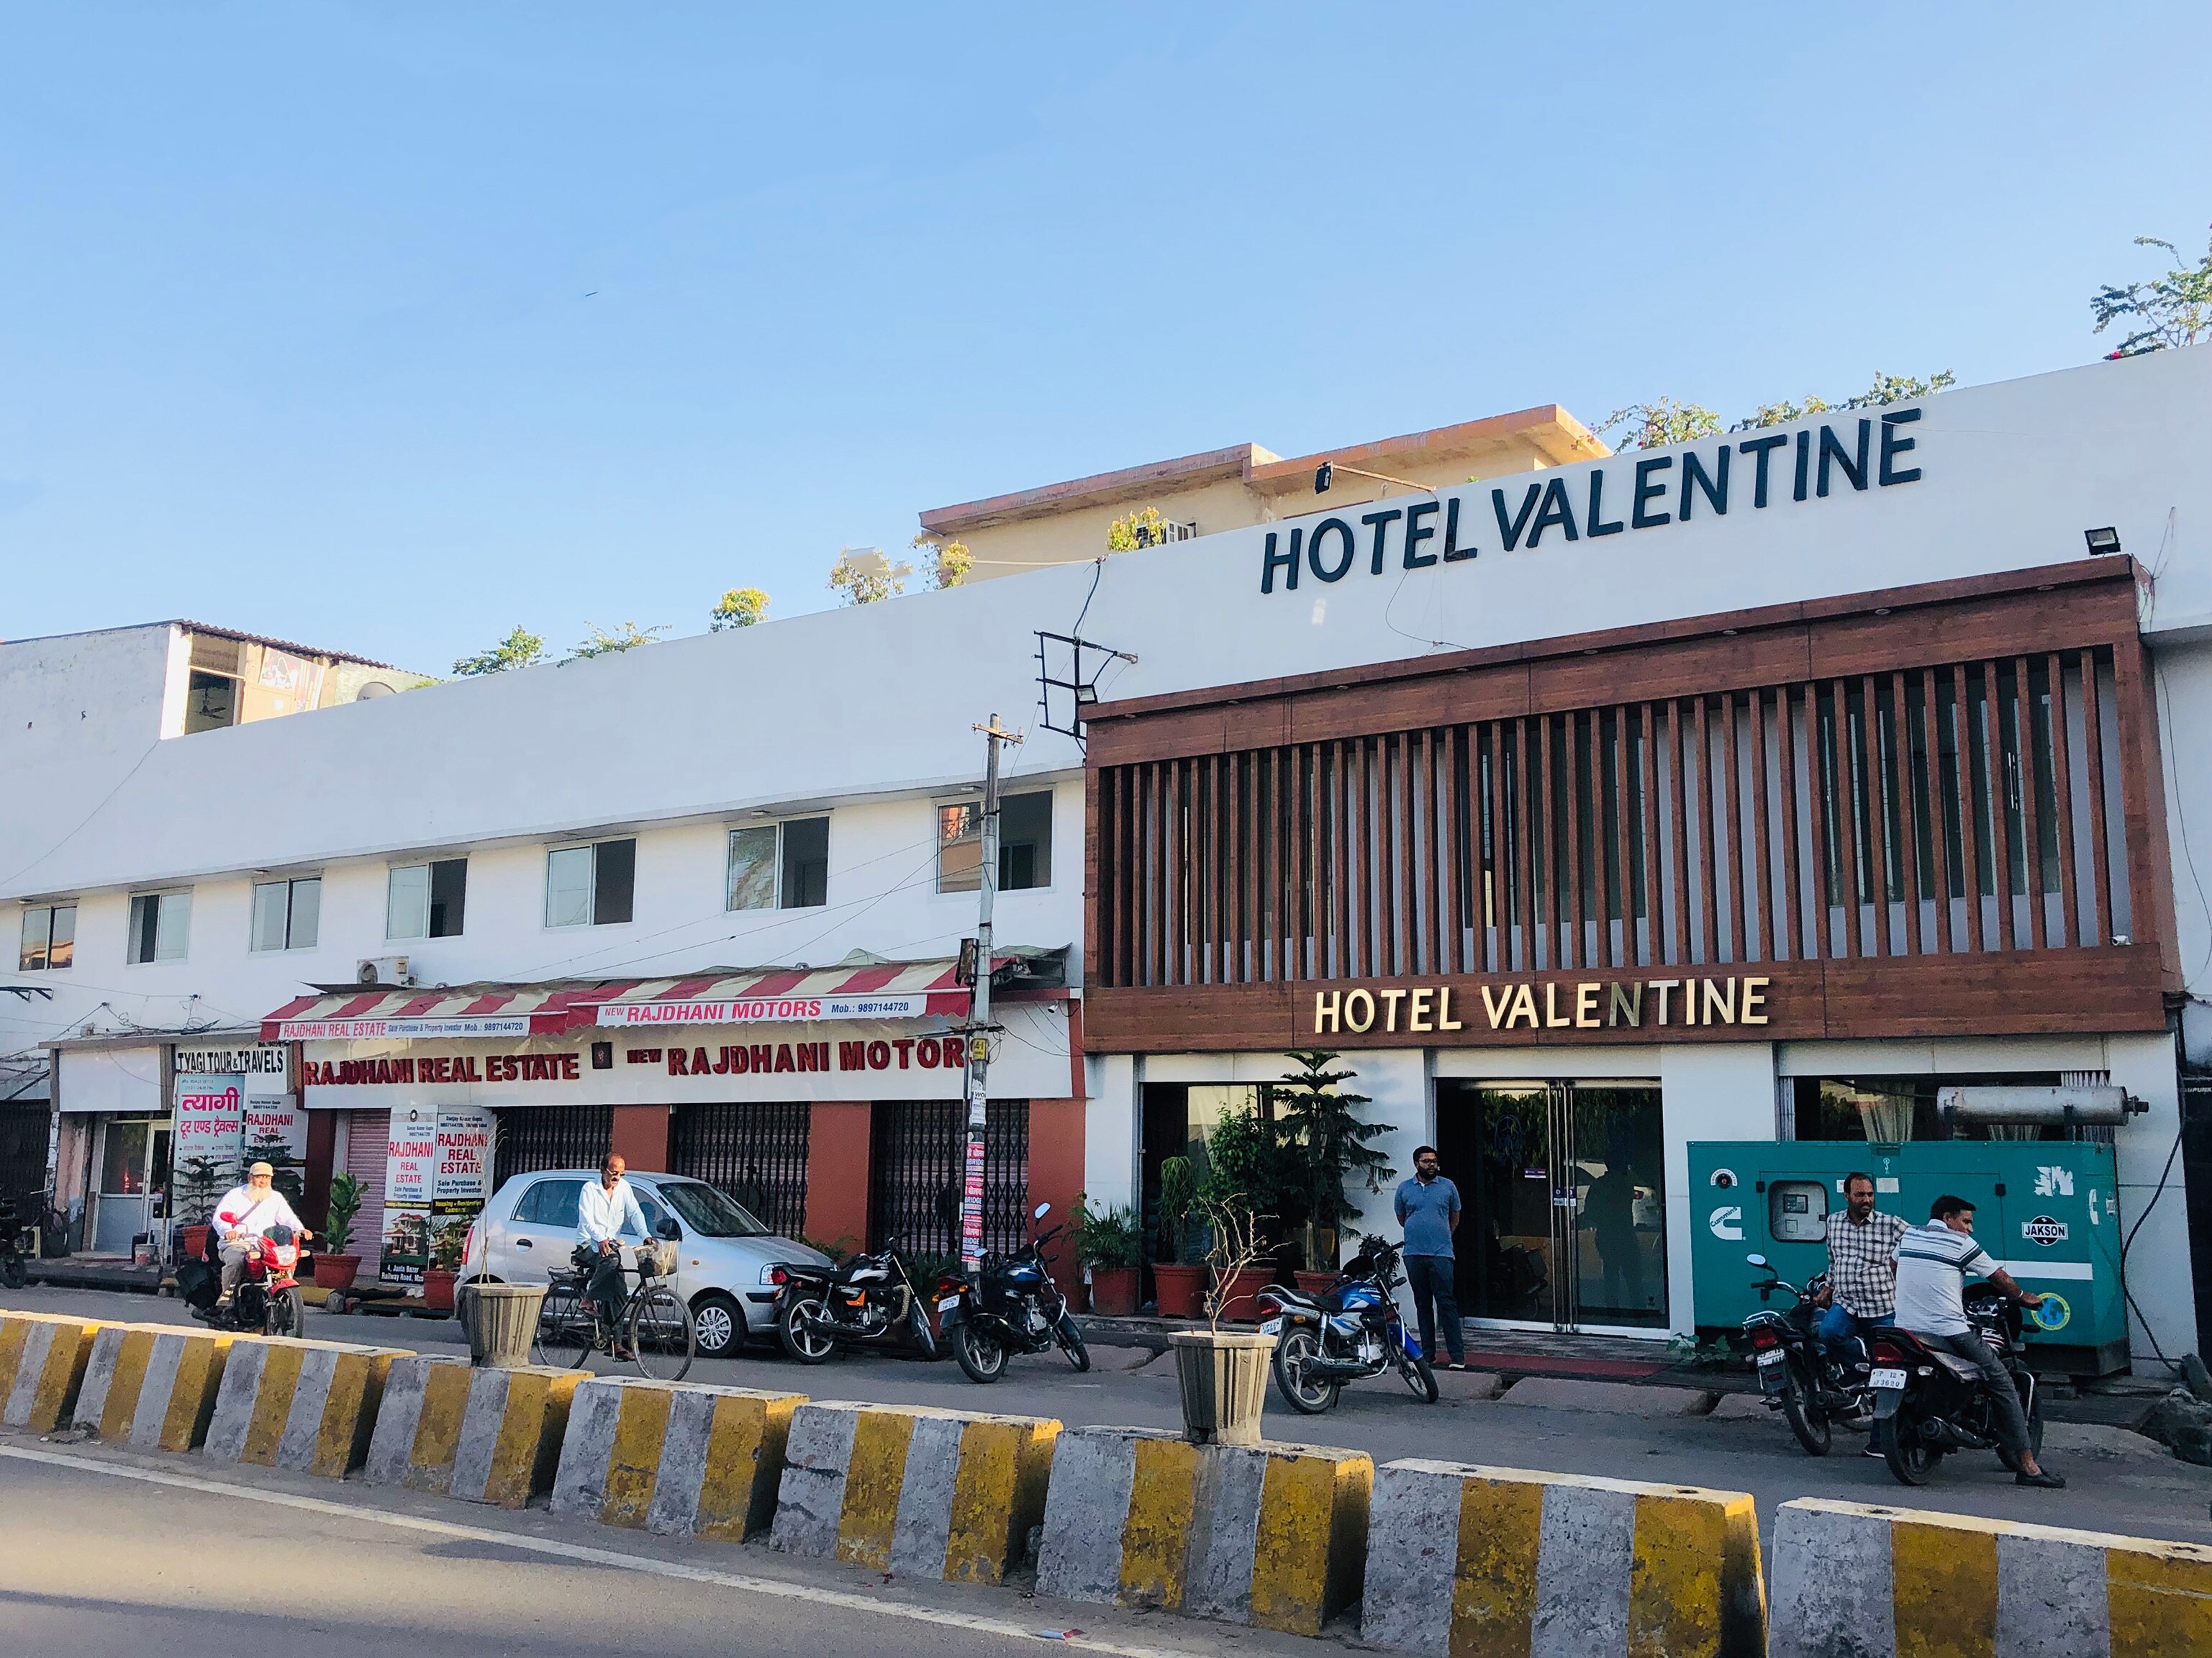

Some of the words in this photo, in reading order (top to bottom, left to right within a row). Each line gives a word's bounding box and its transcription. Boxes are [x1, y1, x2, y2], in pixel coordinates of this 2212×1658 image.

[1261, 497, 1478, 594] HOTEL
[1492, 408, 1922, 552] VALENTINE
[604, 1007, 625, 1016] NEW
[627, 1003, 724, 1022] RAJDHANI
[731, 1000, 822, 1019] MOTORS
[857, 1002, 909, 1013] 9897144720
[1315, 987, 1461, 1033] HOTEL
[1482, 977, 1769, 1030] VALENTINE
[284, 1024, 326, 1038] RAJDHANI
[328, 1023, 350, 1036] REAL
[353, 1022, 387, 1036] ESTATE
[484, 1022, 523, 1031] 9897144720
[178, 1052, 207, 1071] TYAGI
[207, 1051, 232, 1071] TOUR
[232, 1058, 238, 1069] &
[238, 1050, 284, 1073] TRAVELS
[627, 1048, 662, 1063] NEW
[667, 1042, 830, 1076] RAJDHANI
[838, 1037, 987, 1072] MOTOR
[304, 1059, 414, 1085] RAJDHANI
[417, 1056, 482, 1083] REAL
[486, 1053, 580, 1081] ESTATE
[182, 1087, 240, 1112] त्यागी
[248, 1114, 294, 1125] RAJDHANI
[180, 1120, 192, 1139] टूर
[193, 1120, 212, 1133] एण्ड
[438, 1133, 487, 1147] RAJDHANI
[389, 1141, 433, 1158] RAJDHANI
[448, 1149, 476, 1161] REAL
[400, 1161, 418, 1171] REAL
[441, 1162, 481, 1174] ESTATE
[396, 1174, 422, 1183] ESTATE
[1710, 1207, 1738, 1228] Cummins
[2025, 1226, 2065, 1236] JAKSON
[381, 1272, 399, 1282] Railway
